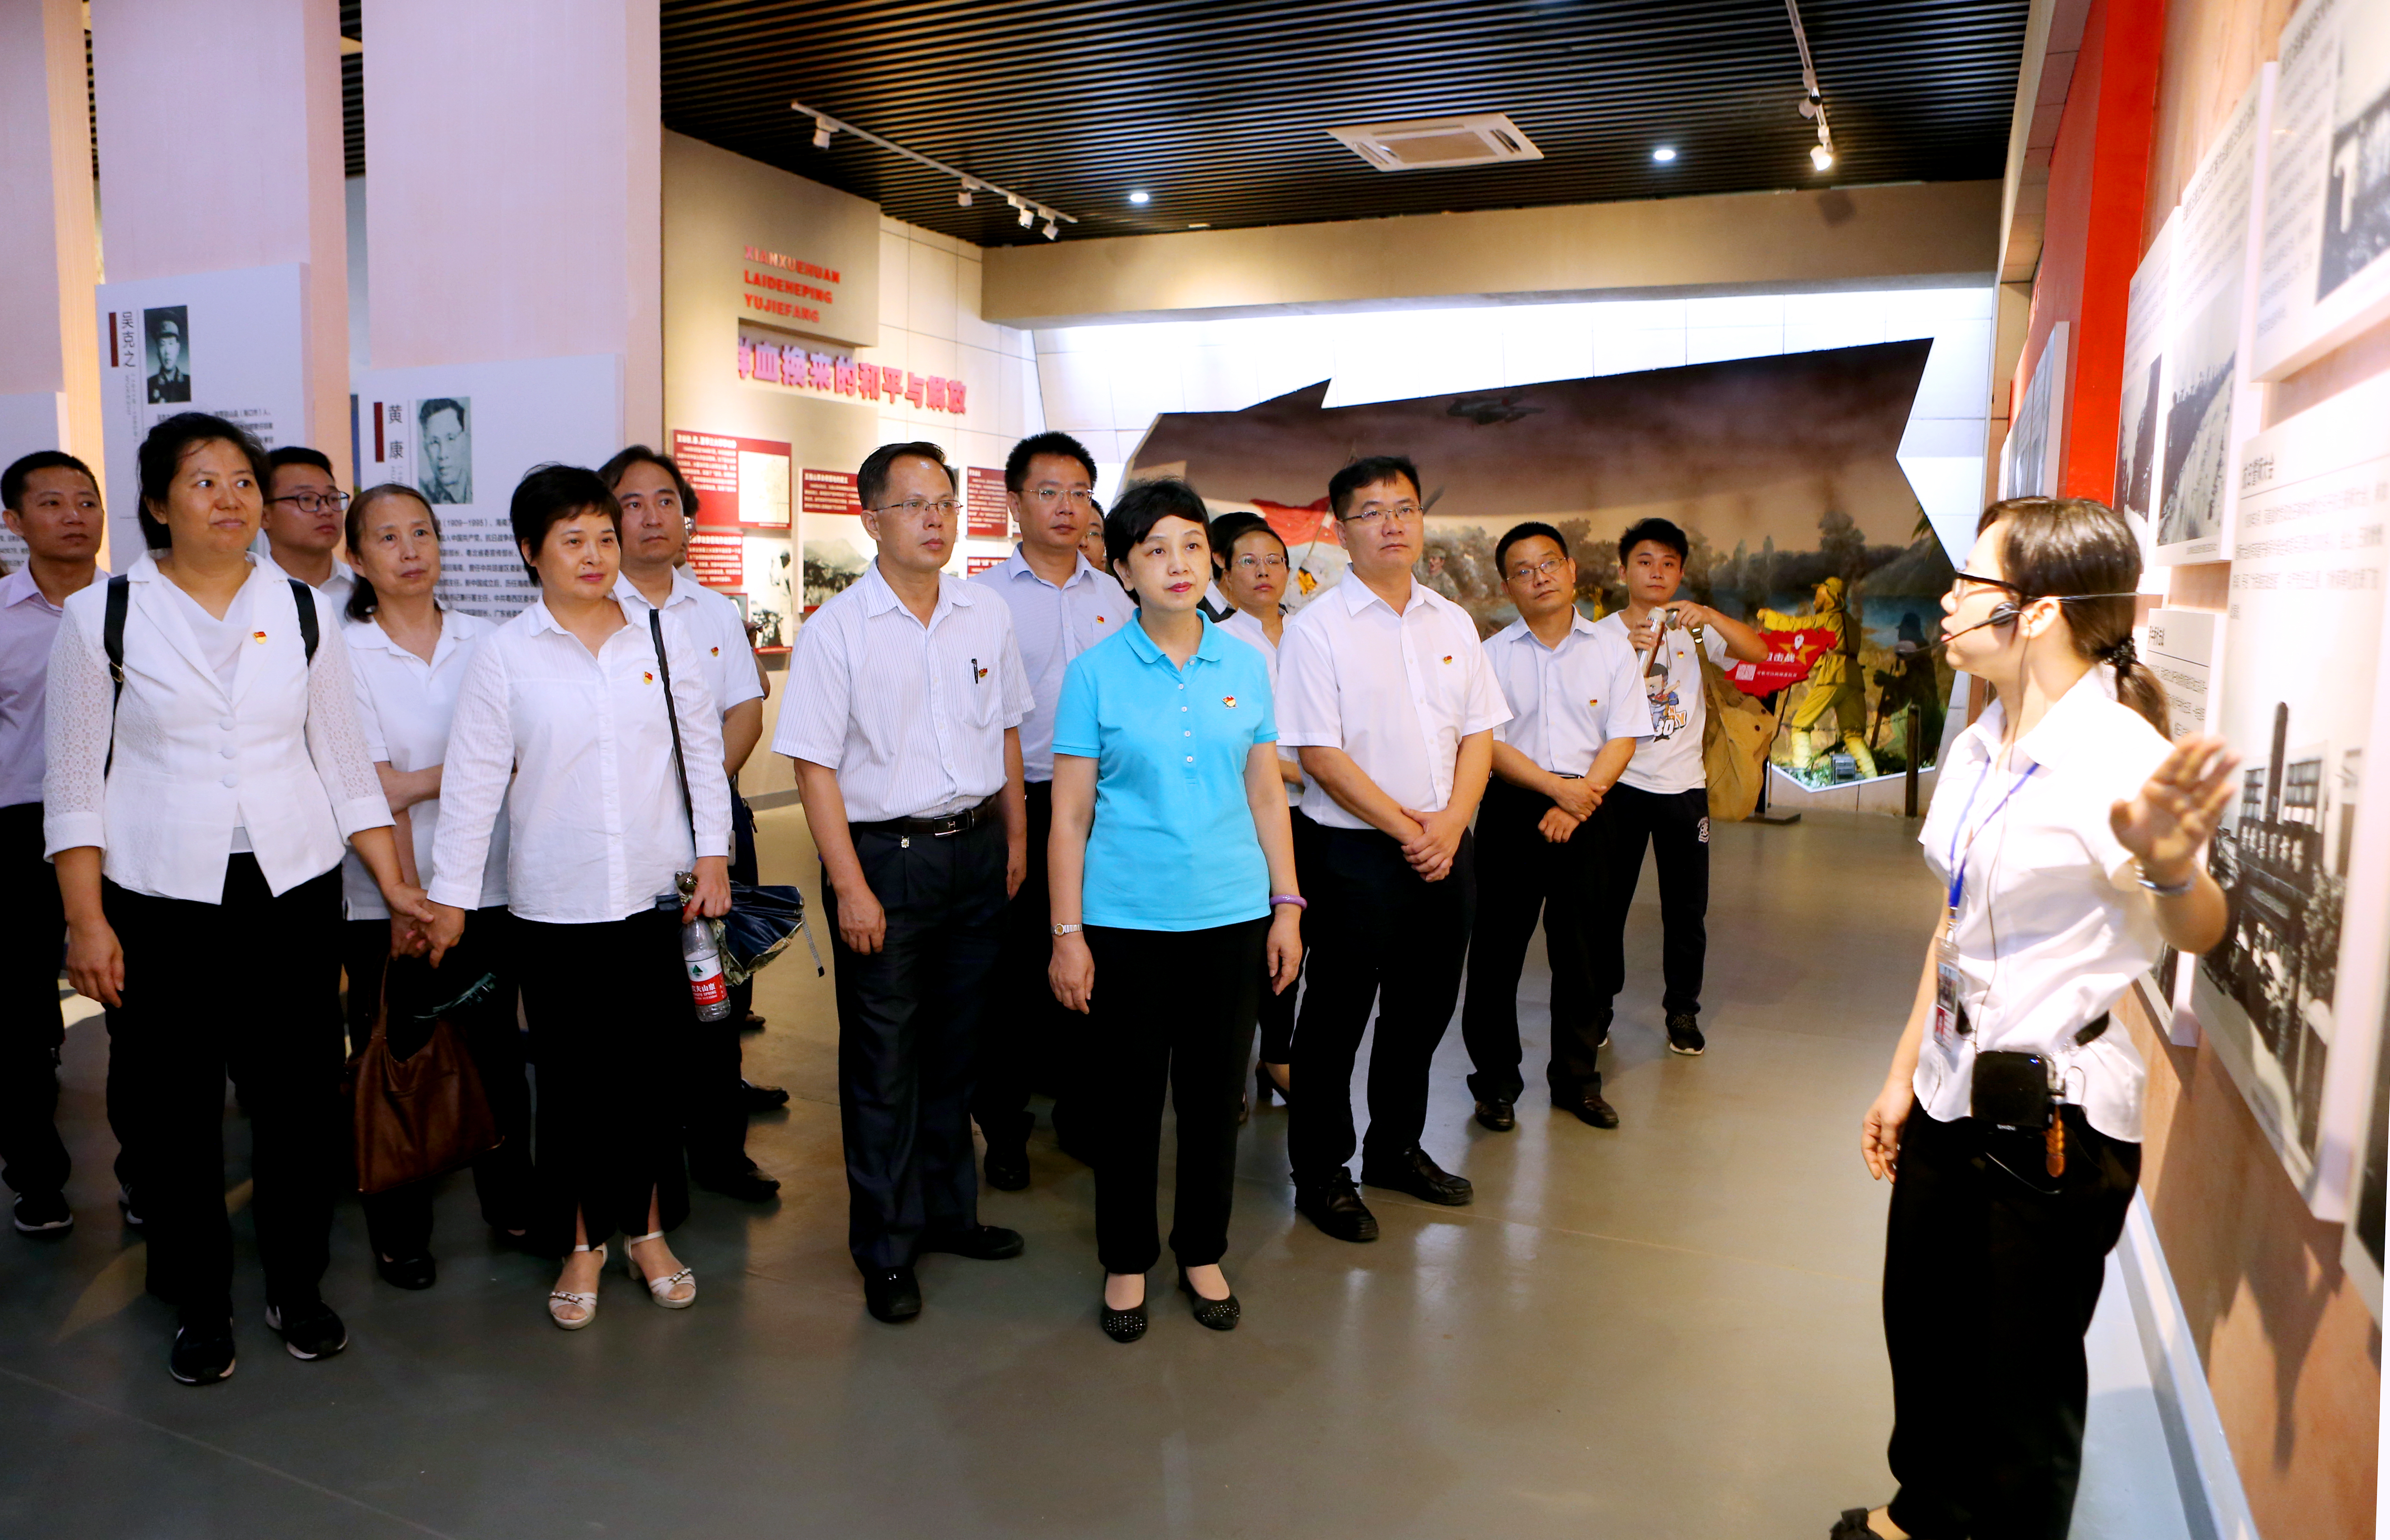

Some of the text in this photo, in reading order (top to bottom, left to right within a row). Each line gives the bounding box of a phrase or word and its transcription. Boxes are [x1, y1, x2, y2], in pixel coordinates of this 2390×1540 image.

[744, 244, 841, 285] XIANXUEHUAN
[744, 269, 833, 304] LAIDEHEPING
[744, 293, 820, 323] YUJIEFANG
[1654, 719, 1675, 737] 30
